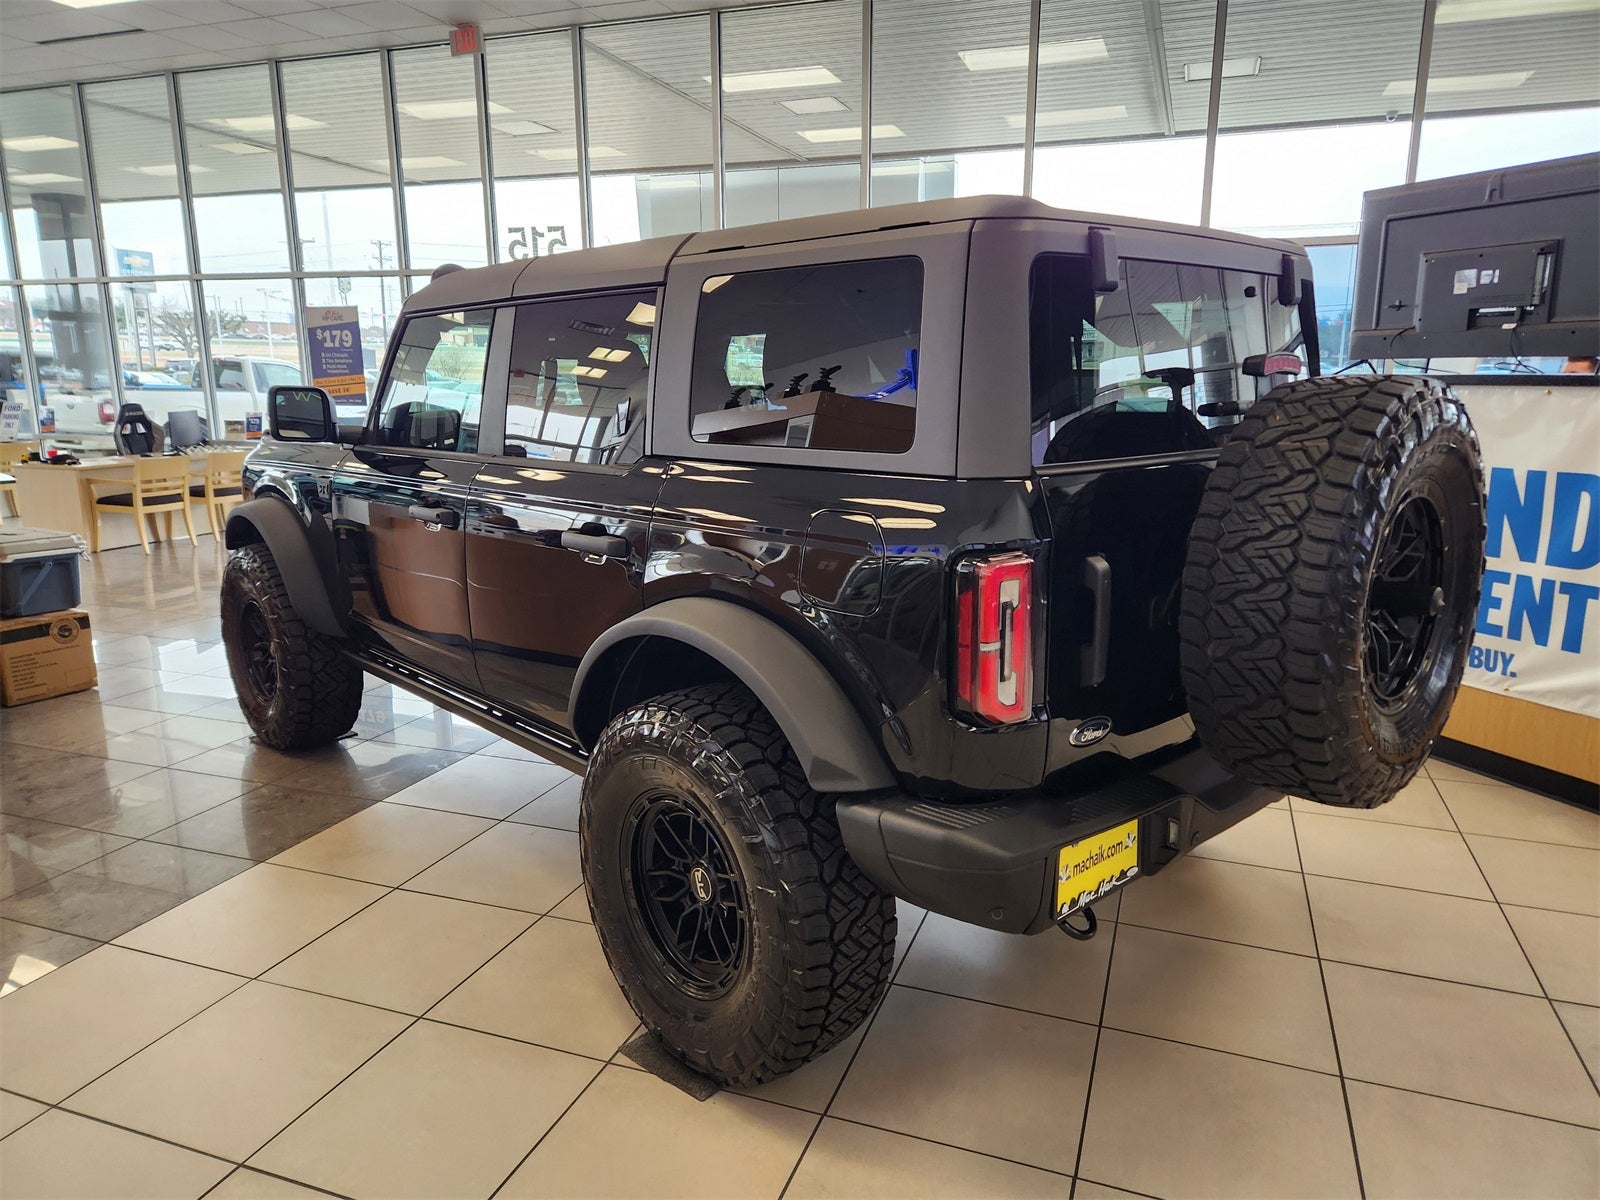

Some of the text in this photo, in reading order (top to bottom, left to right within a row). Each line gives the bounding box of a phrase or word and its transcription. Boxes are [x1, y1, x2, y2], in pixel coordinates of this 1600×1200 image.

[454, 26, 477, 53] EXIT
[316, 328, 353, 348] $179
[1468, 646, 1517, 678] BUY.
[1080, 726, 1105, 743] Ford
[1072, 840, 1123, 877] machaik.com
